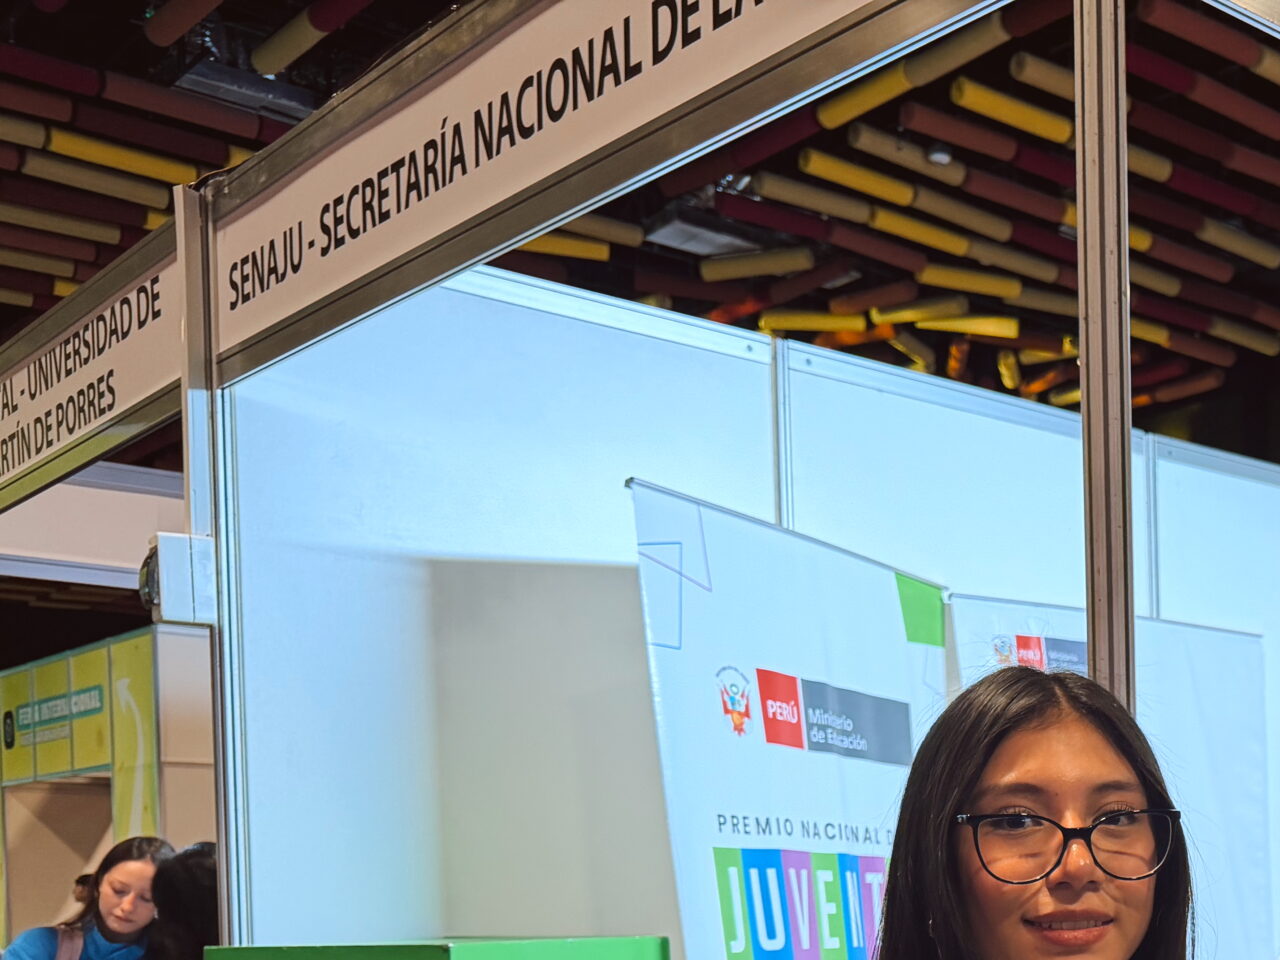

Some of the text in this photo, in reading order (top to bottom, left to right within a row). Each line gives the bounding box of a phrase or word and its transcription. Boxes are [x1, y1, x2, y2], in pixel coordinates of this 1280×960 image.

[229, 220, 303, 311] SENAJU
[320, 116, 468, 257] SECRETARÍA
[473, 16, 642, 168] NACIONAL
[652, 0, 702, 66] DE
[0, 376, 18, 421] AL
[27, 296, 132, 401] UNIVERSIDAD
[136, 275, 162, 330] DE
[0, 368, 116, 477] RTÍN DE PORRES
[766, 699, 798, 724] PERÚ
[810, 726, 826, 743] de
[717, 814, 794, 837] PREMIO
[727, 866, 886, 953] JUVENT
